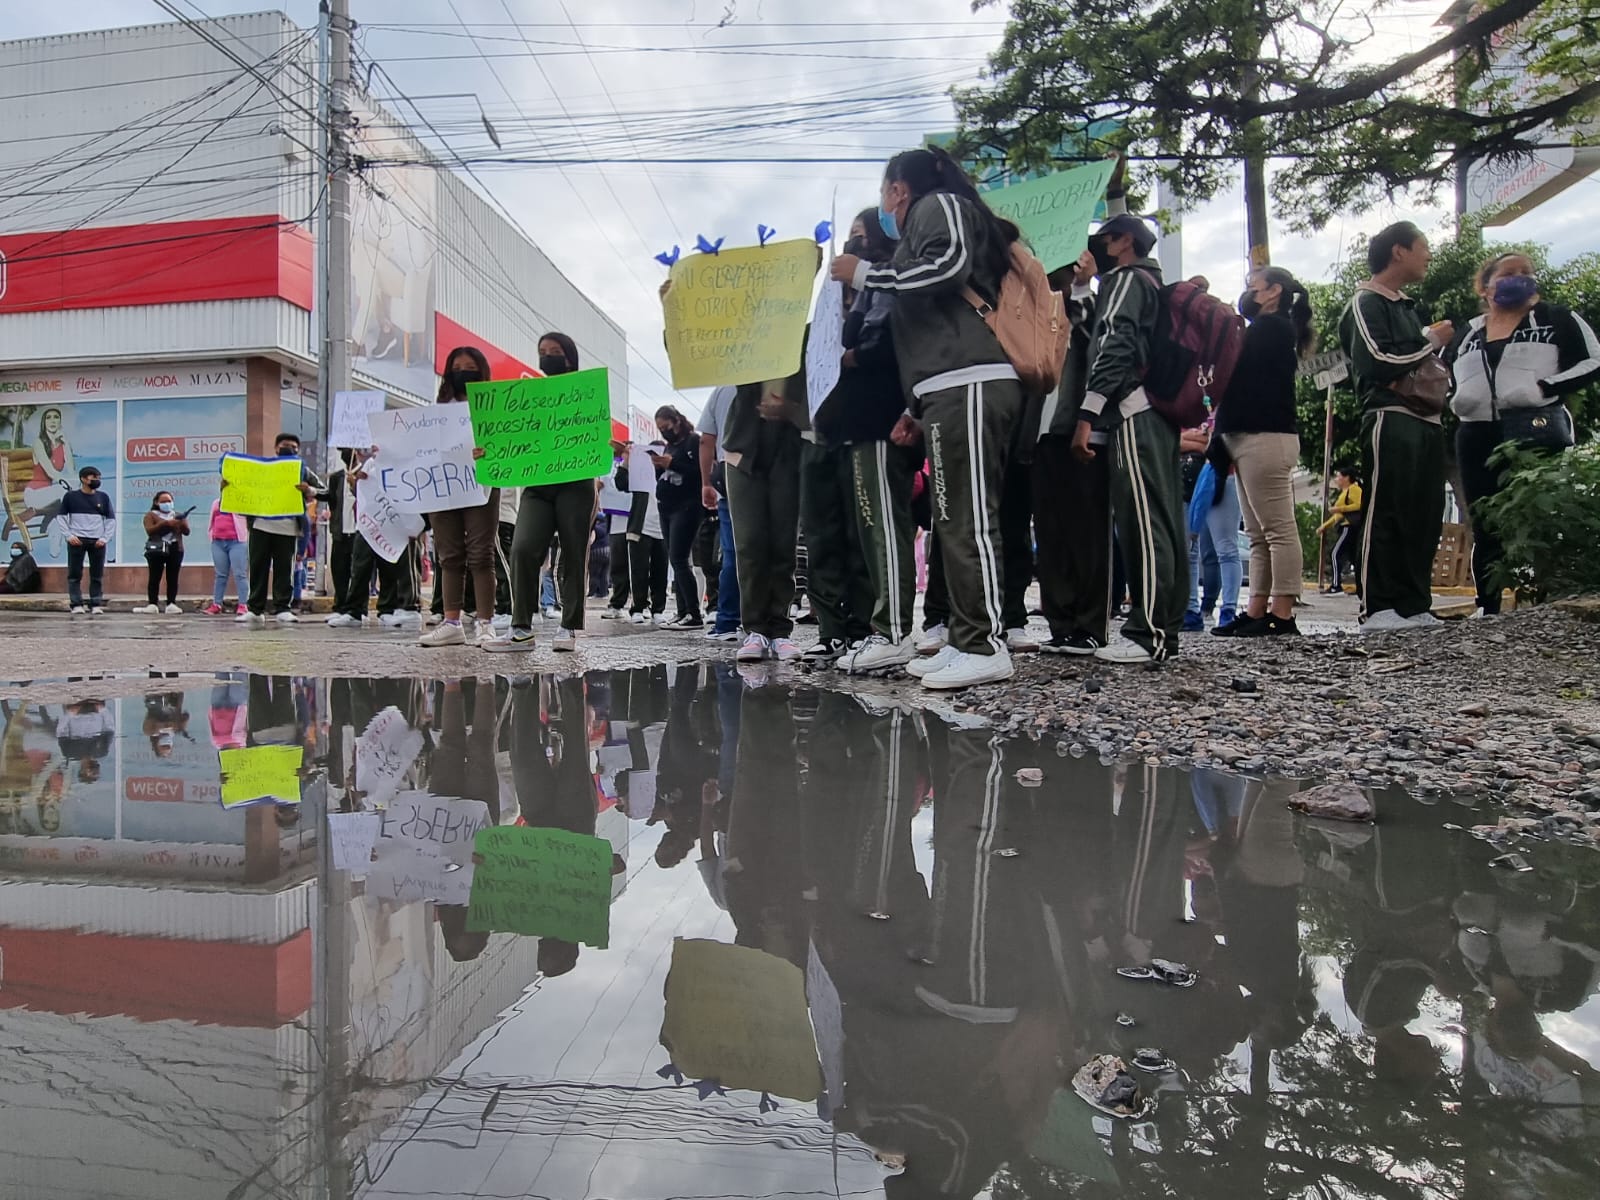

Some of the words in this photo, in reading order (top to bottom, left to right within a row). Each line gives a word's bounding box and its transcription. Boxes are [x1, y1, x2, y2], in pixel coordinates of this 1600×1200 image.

[76, 377, 102, 394] flexi
[112, 375, 179, 389] MEGAMODA
[478, 413, 541, 438] necesita
[133, 443, 181, 458] MEGA
[192, 440, 237, 454] shoes
[484, 440, 542, 461] Salones
[521, 463, 539, 478] mi
[131, 479, 162, 488] VENTA
[165, 478, 185, 487] POR
